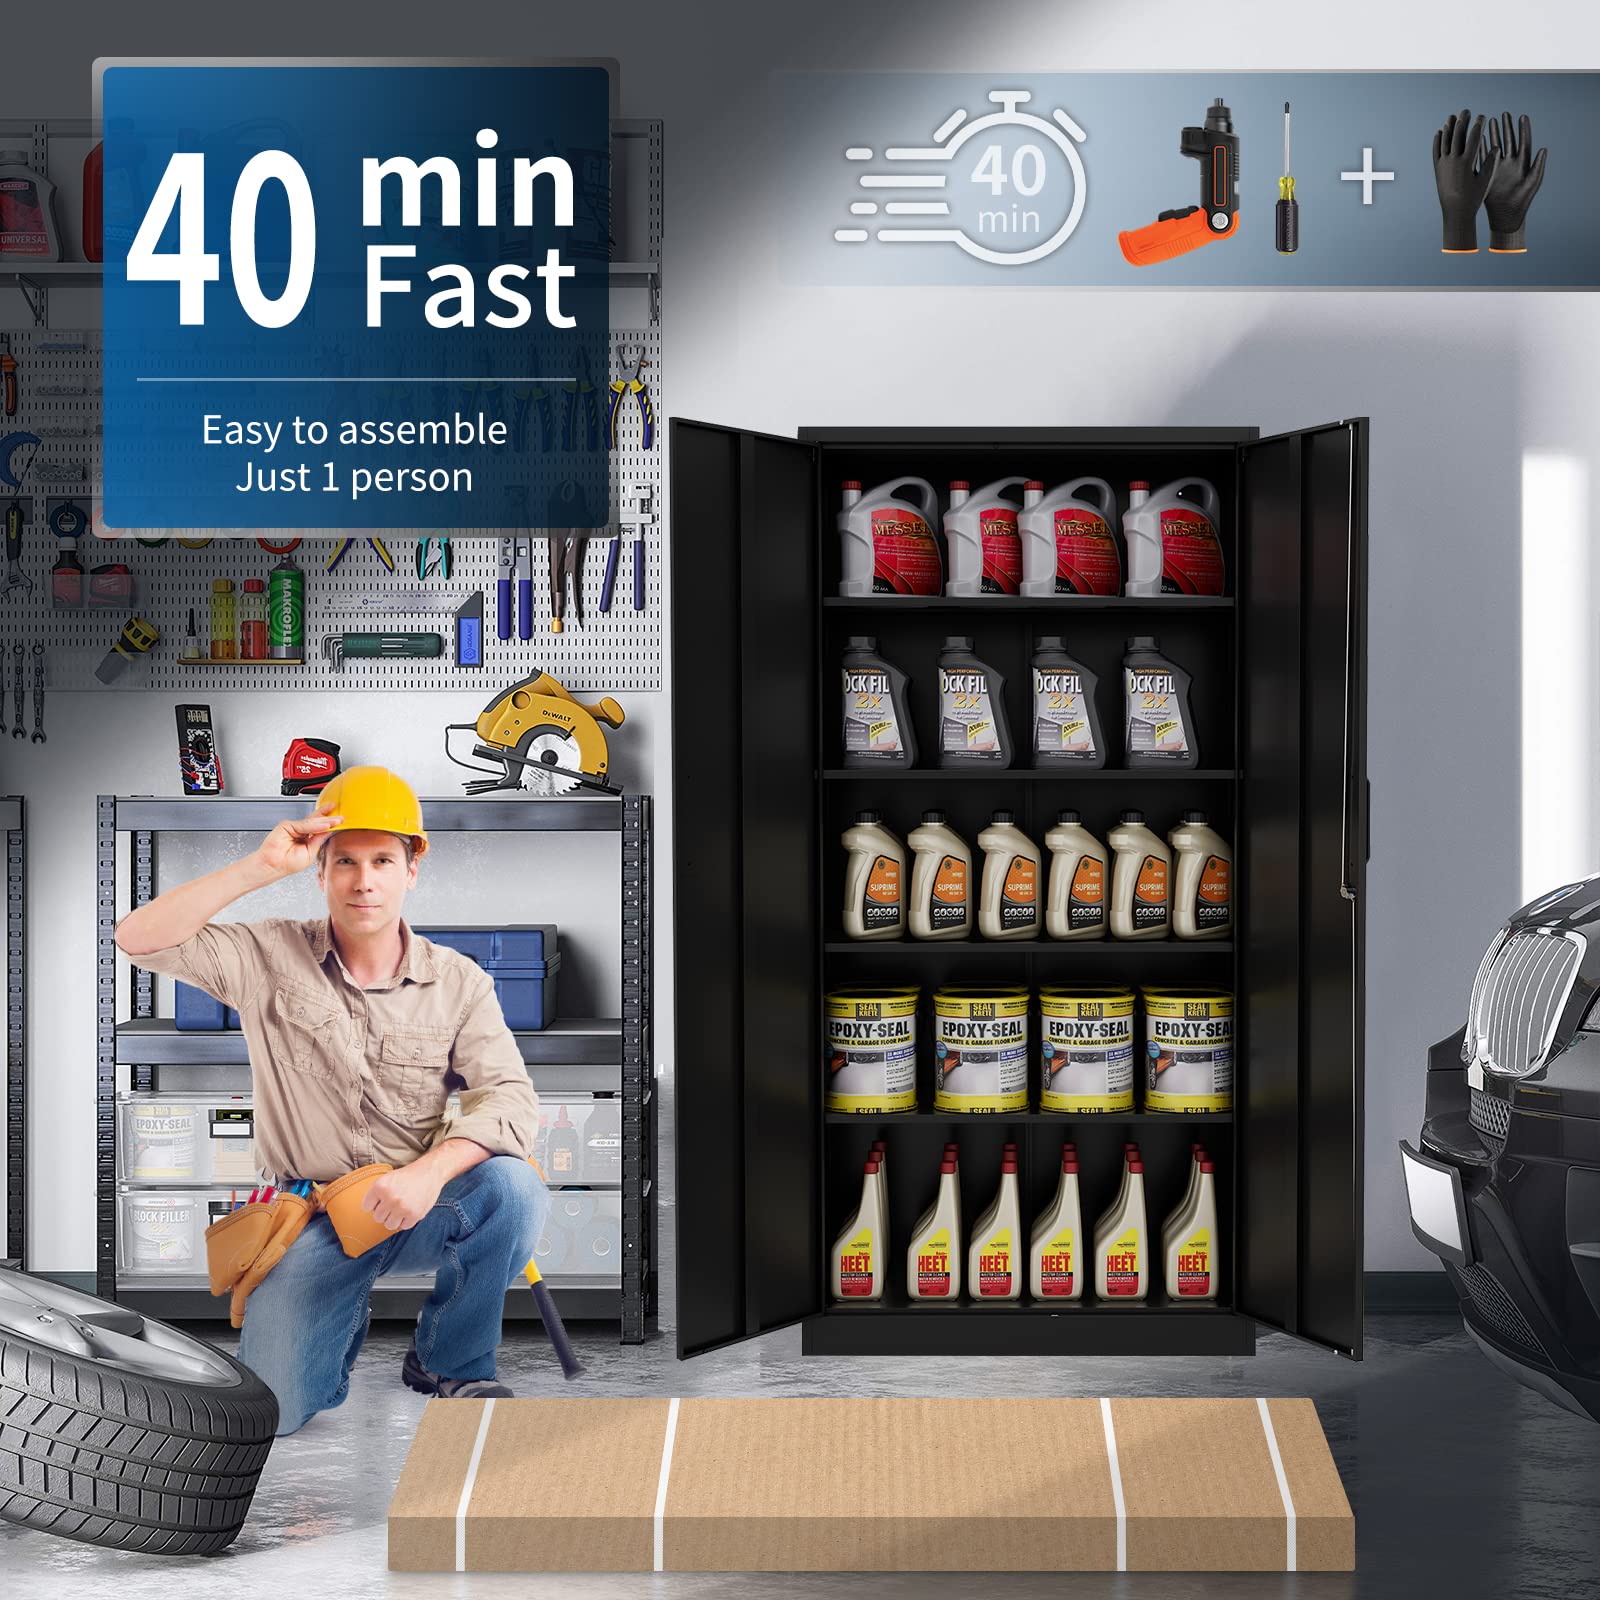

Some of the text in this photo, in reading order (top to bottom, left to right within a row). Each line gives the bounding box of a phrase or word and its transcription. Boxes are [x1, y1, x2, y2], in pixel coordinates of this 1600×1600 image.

[1, 235, 47, 244] UNIVERSAL
[829, 1021, 910, 1038] EPOXY-SEAL
[942, 1021, 1022, 1038] EPOXY-SEAL
[1050, 1021, 1129, 1038] EPOXY-SEAL
[136, 1118, 192, 1130] EPOXY-SEAL
[841, 1256, 870, 1272] HEET
[918, 1256, 947, 1272] HEET
[980, 1256, 1009, 1272] HEET
[1041, 1256, 1070, 1272] HEET
[1107, 1256, 1136, 1272] HEET
[1178, 1256, 1207, 1272] HEET
